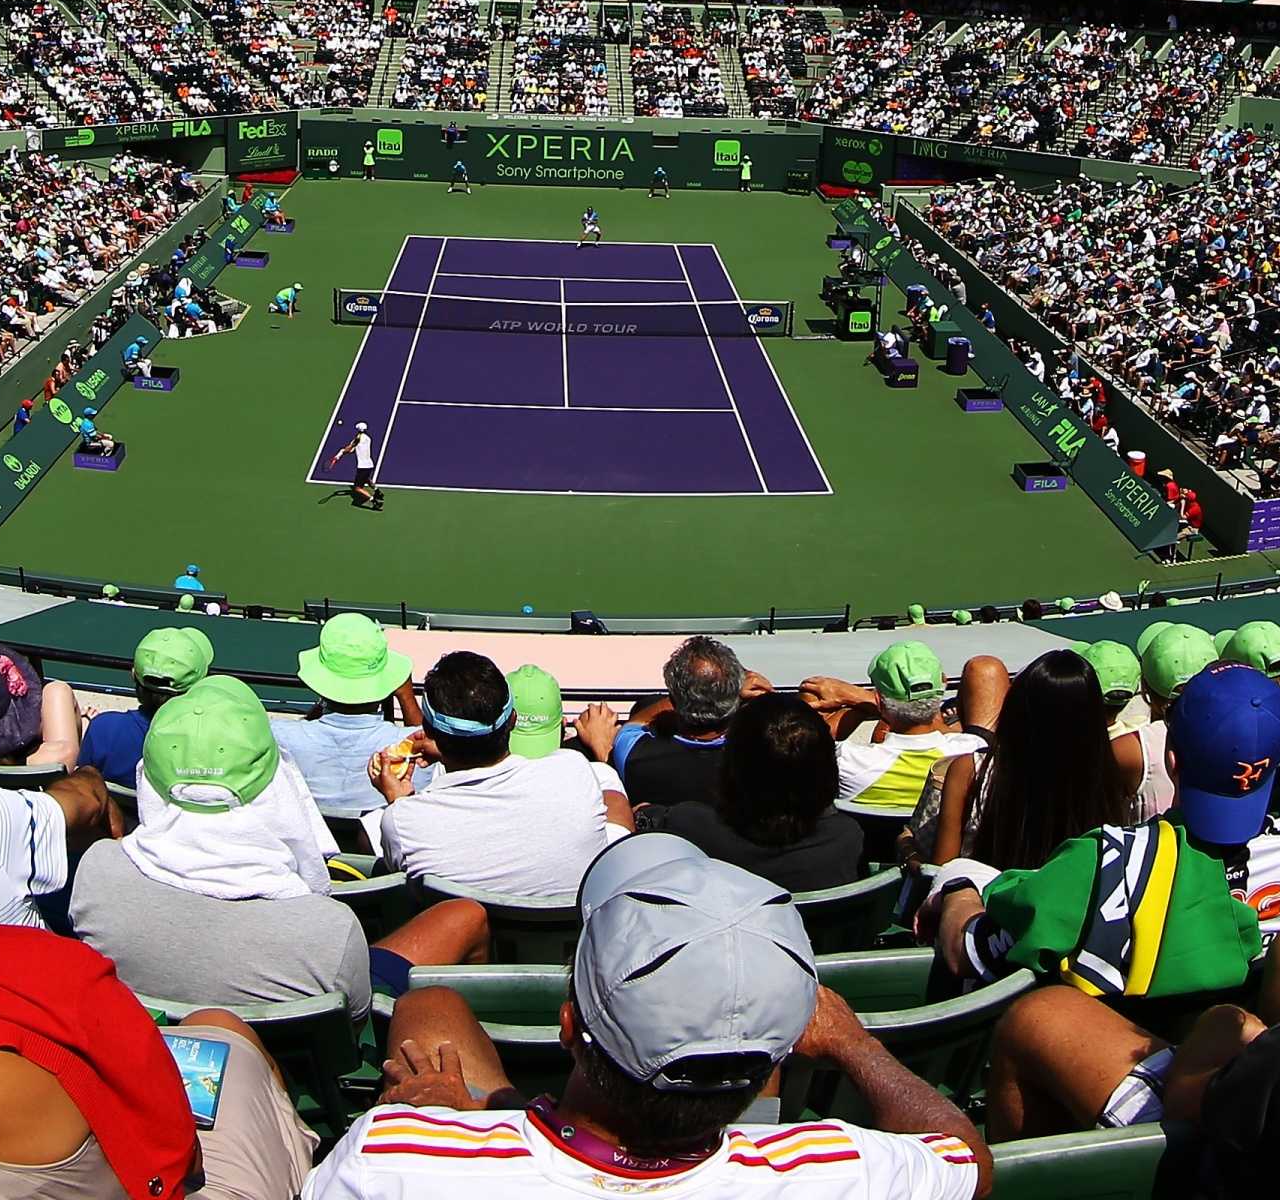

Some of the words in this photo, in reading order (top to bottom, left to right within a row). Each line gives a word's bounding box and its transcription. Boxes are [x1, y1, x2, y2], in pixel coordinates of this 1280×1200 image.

[114, 124, 160, 136] XPERIA
[172, 120, 212, 138] FILA
[238, 118, 288, 140] FedEx
[378, 140, 401, 151] Itaú
[486, 134, 634, 162] XPERIA
[835, 137, 866, 150] xerox
[912, 140, 948, 159] IMG
[308, 148, 338, 156] RADO
[716, 150, 738, 162] Itaú
[963, 146, 1008, 160] XPERIA
[496, 164, 532, 180] Sony
[535, 165, 624, 181] Smartphone
[346, 302, 378, 313] Corona
[748, 314, 780, 324] Corona
[850, 320, 870, 330] Itaú
[489, 320, 522, 330] ATP
[528, 322, 588, 332] WORLD
[593, 324, 638, 334] TOUR
[86, 368, 106, 389] USANA
[141, 379, 164, 388] FILA
[1031, 392, 1050, 410] LAN
[52, 404, 68, 417] WTA
[1020, 404, 1042, 427] AIRLINES
[1048, 418, 1087, 458] FILA
[80, 456, 110, 464] XPERIA
[1034, 479, 1058, 488] FILA
[1112, 471, 1160, 520] XPERIA
[1104, 488, 1116, 504] Sony
[1114, 500, 1141, 528] Smartphone
[614, 1151, 670, 1168] XPERIA
